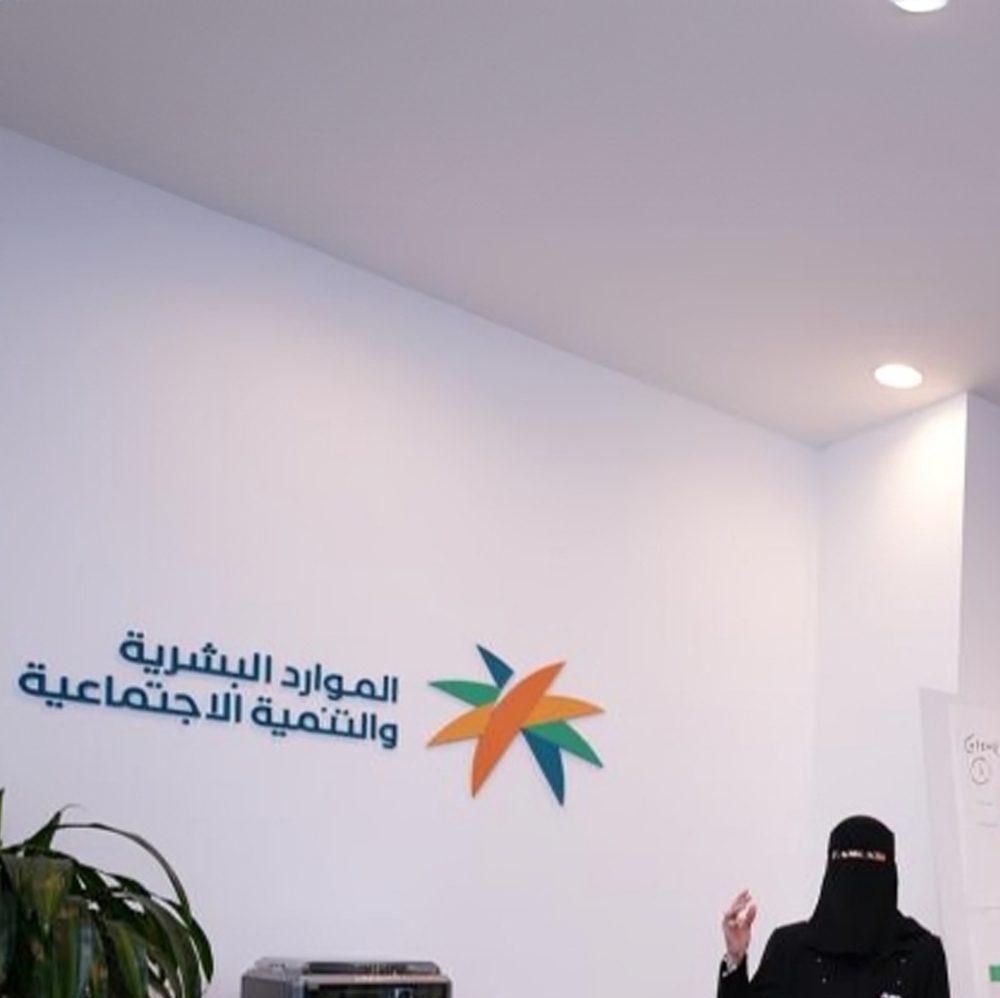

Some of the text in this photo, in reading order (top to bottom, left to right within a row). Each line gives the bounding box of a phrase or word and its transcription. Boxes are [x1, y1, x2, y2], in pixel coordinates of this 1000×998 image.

[18, 661, 399, 749] والتنمية الاجتماعية
[118, 630, 399, 704] الموارد البشرية
